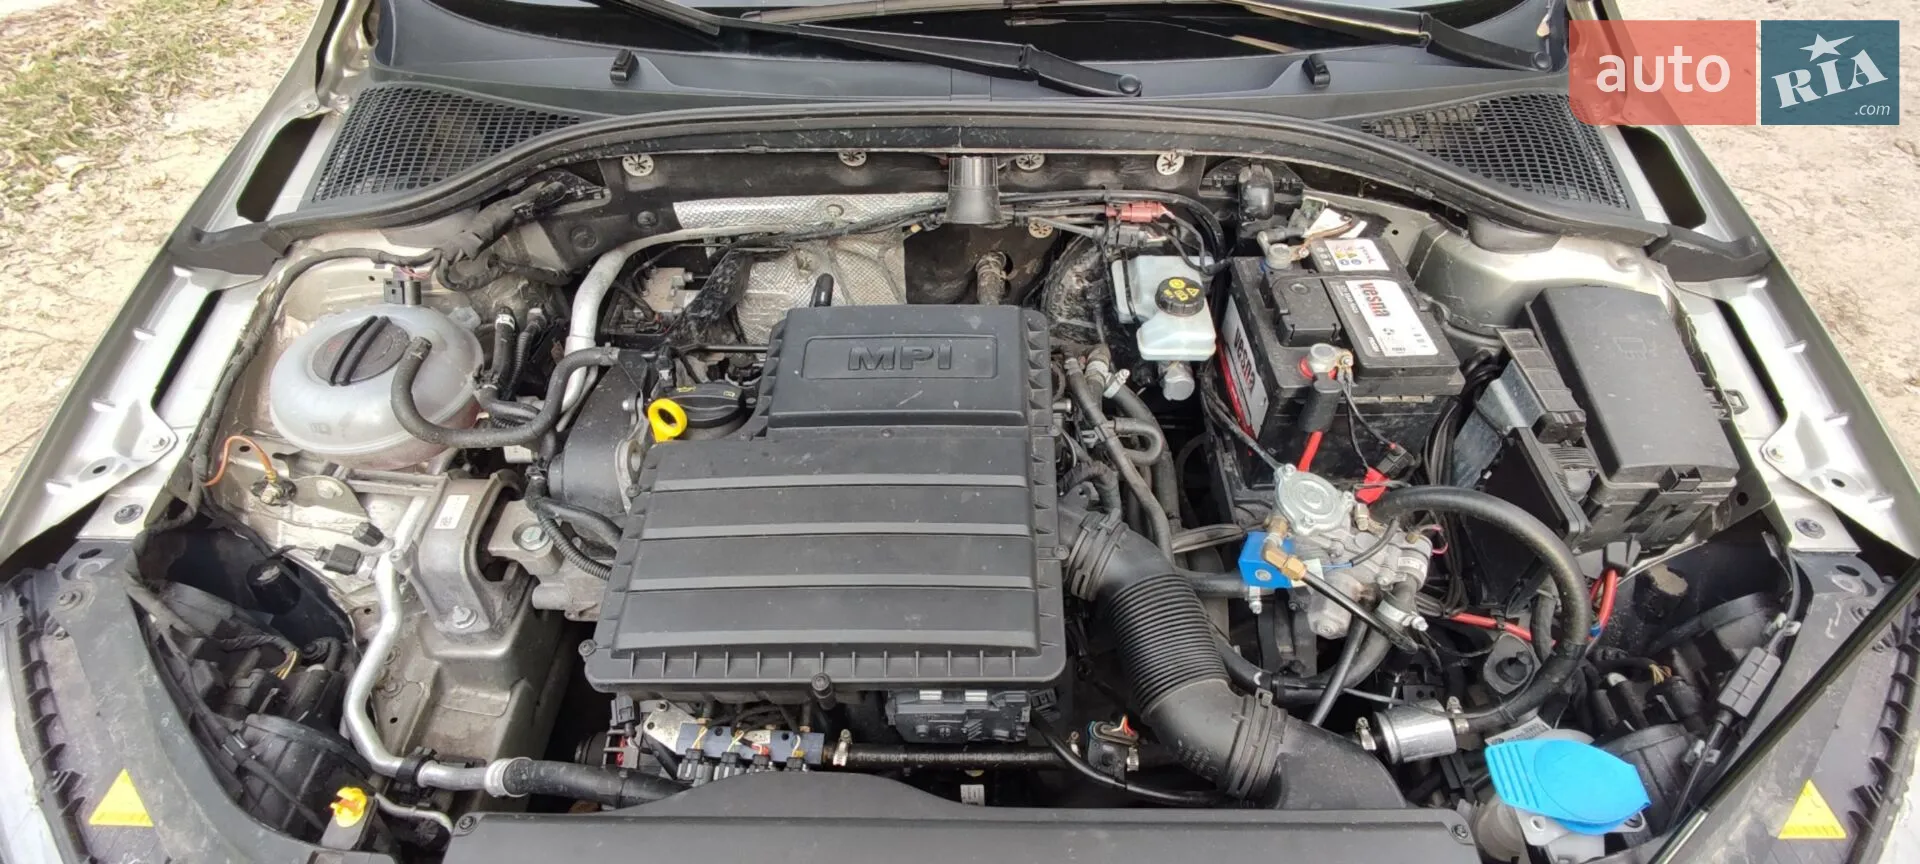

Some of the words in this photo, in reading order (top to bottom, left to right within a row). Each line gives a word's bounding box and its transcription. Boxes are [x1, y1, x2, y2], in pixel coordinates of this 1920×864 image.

[1359, 282, 1391, 318] vesna
[847, 346, 953, 371] MPI
[1234, 326, 1256, 394] vesna
